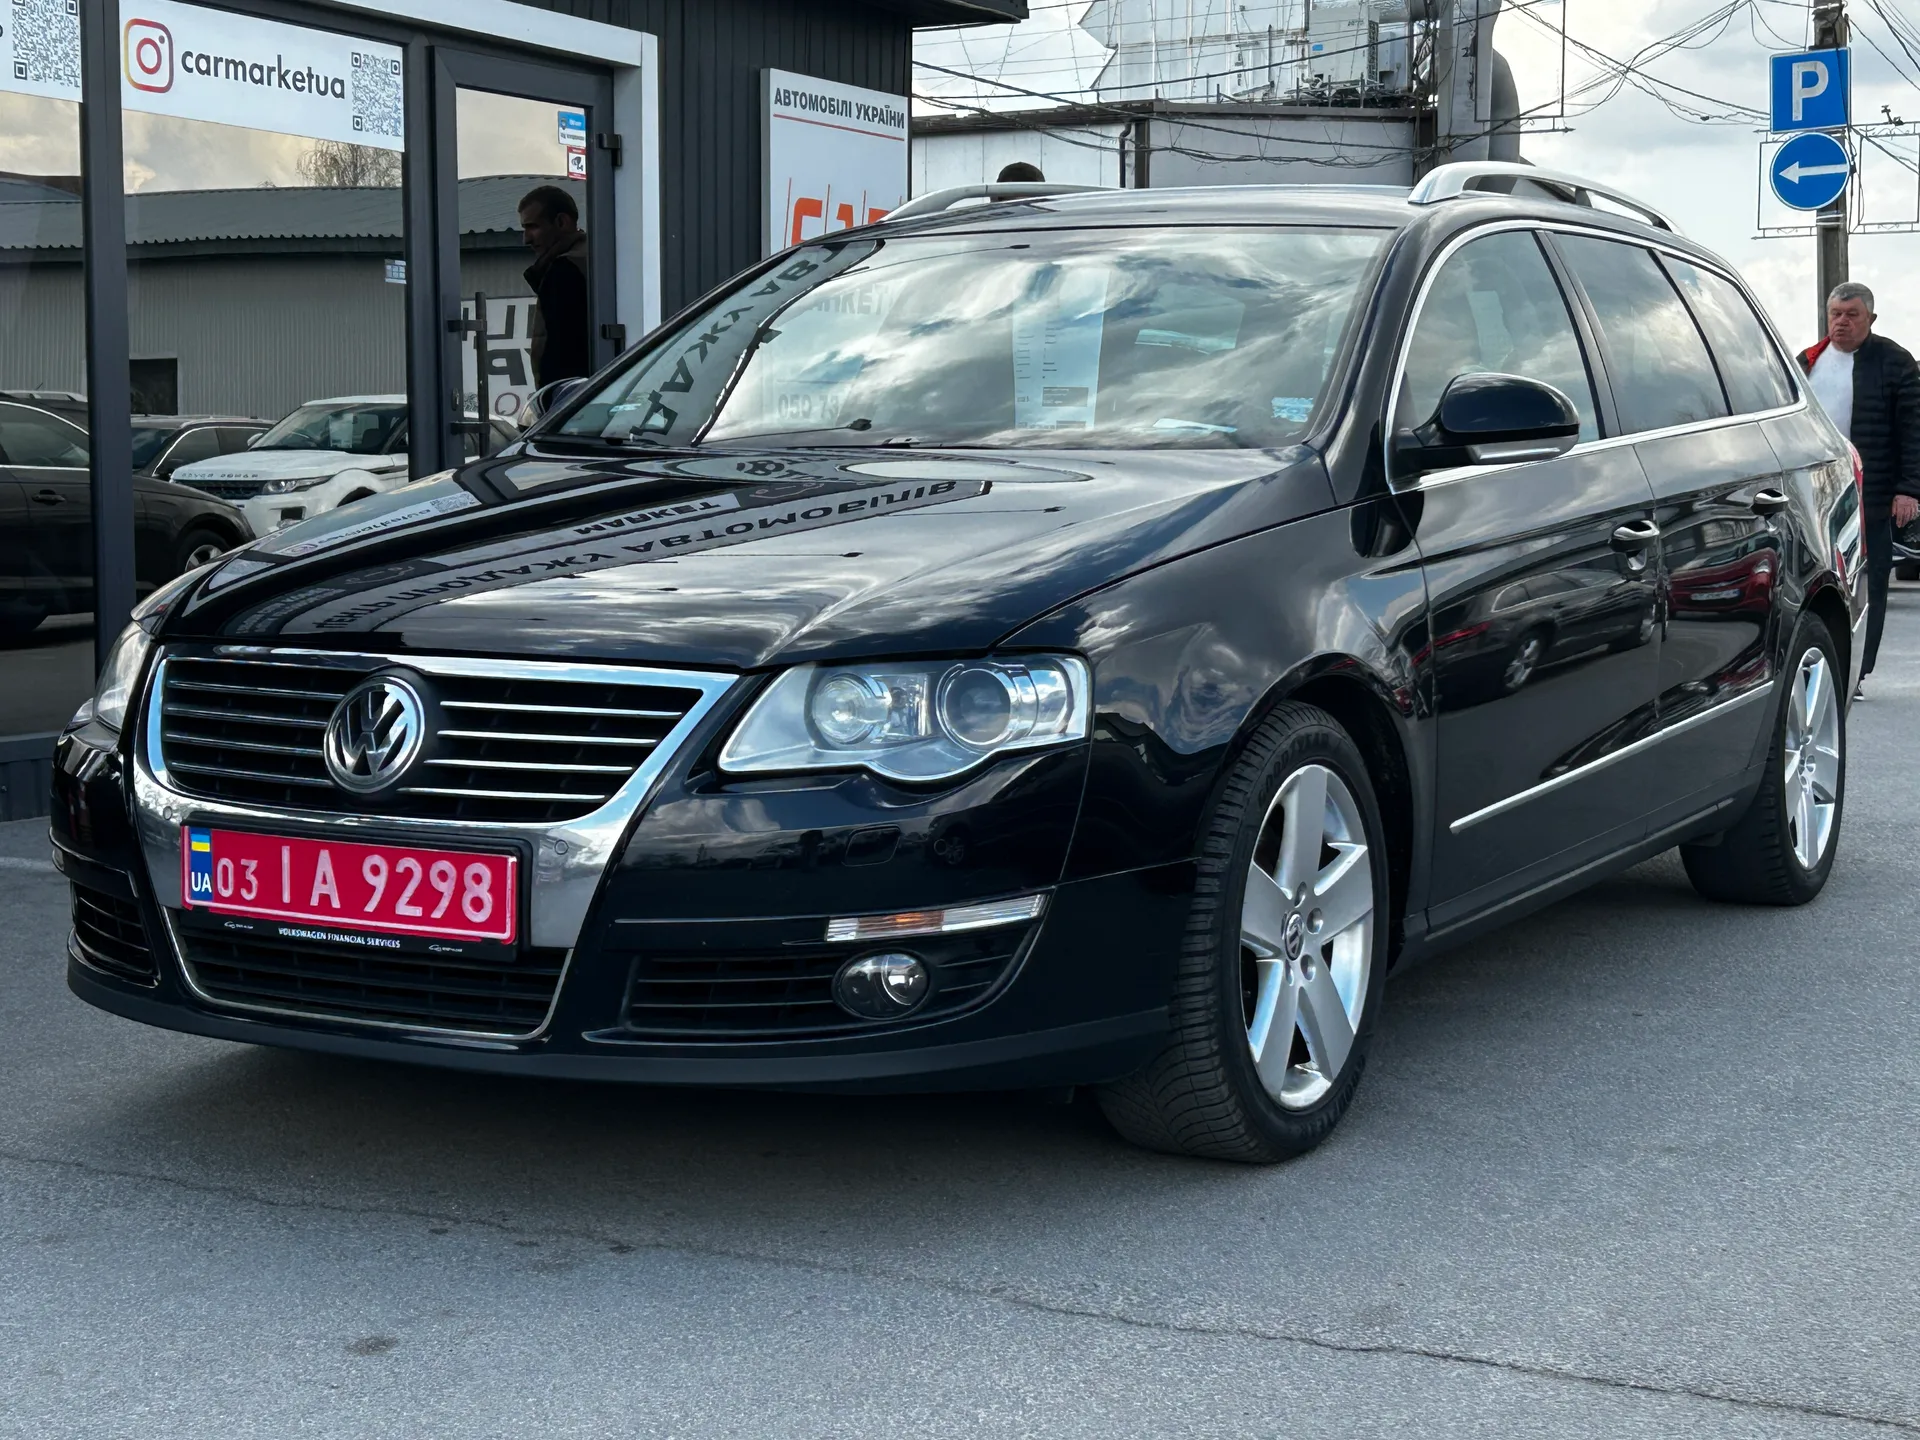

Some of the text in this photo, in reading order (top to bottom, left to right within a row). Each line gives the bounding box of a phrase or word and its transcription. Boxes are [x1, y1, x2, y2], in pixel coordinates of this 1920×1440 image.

[181, 49, 346, 99] carmarketua
[1792, 60, 1829, 121] P
[774, 87, 905, 129] АВТОМОБІЛІ УКРАЇНИ
[191, 872, 212, 893] UA
[216, 857, 259, 901] 03
[362, 854, 493, 923] 9298
[278, 928, 326, 940] VOLKSWAGEN
[366, 937, 401, 949] SERVICES
